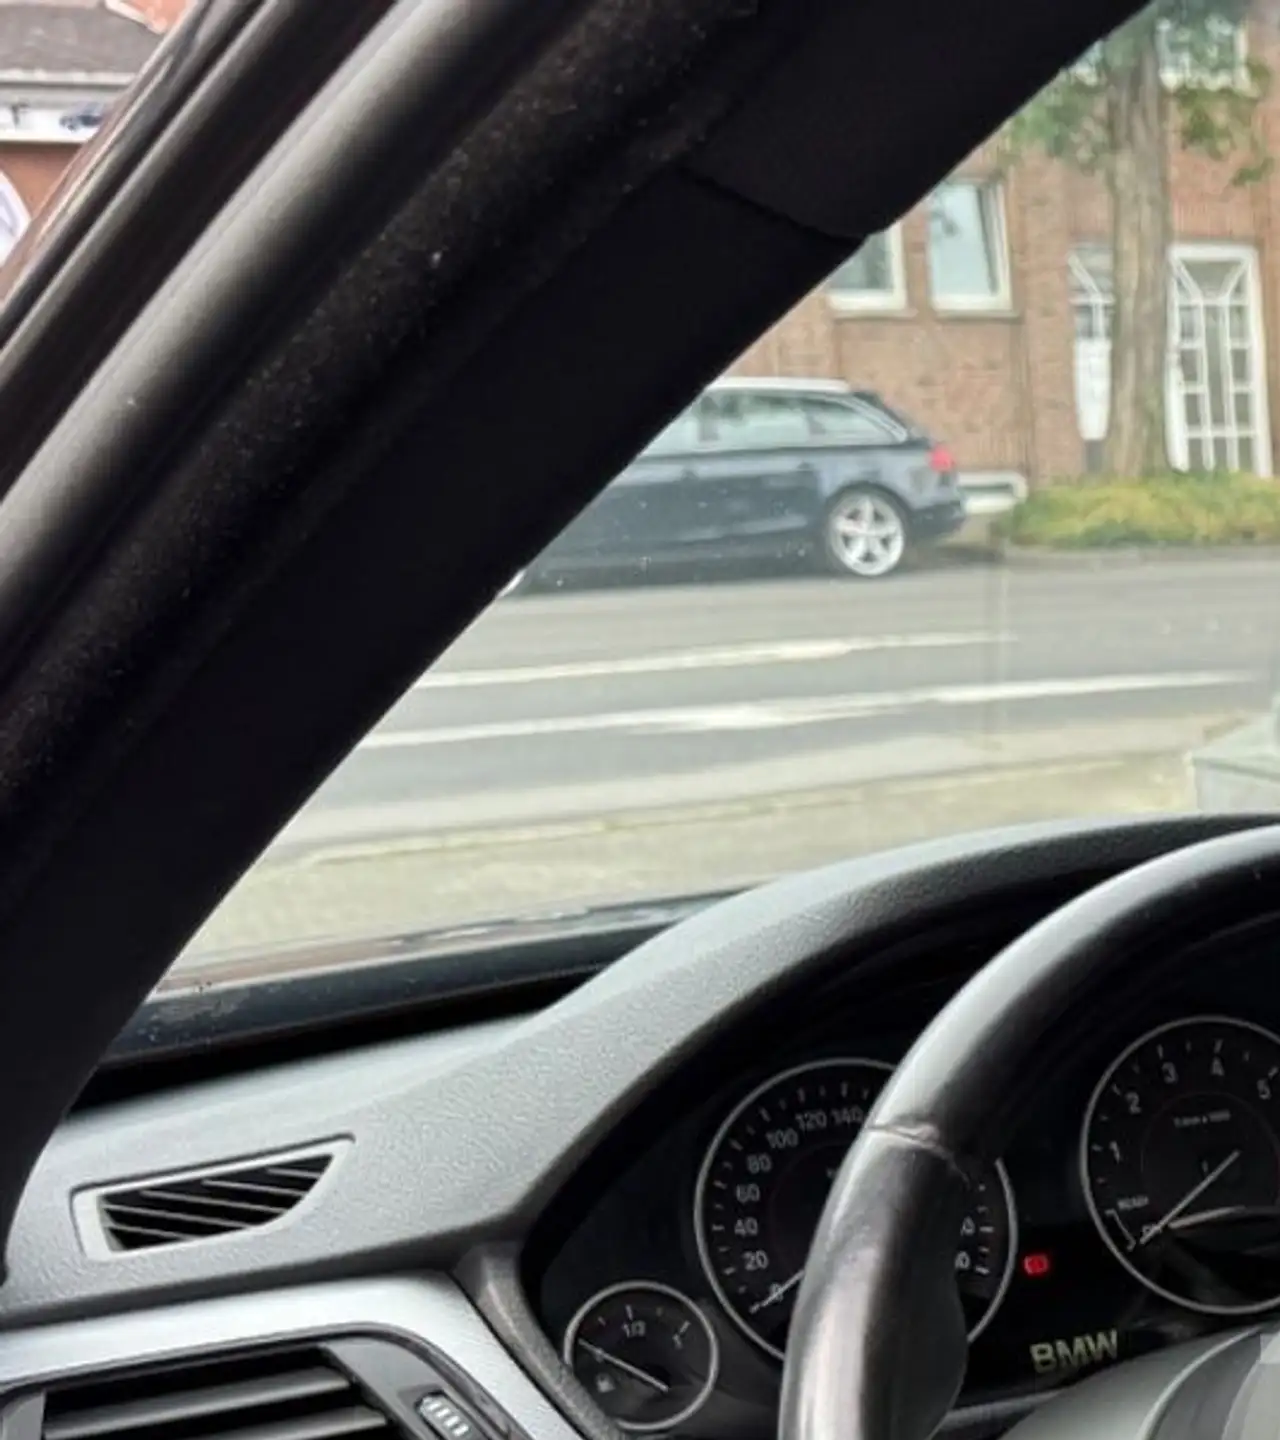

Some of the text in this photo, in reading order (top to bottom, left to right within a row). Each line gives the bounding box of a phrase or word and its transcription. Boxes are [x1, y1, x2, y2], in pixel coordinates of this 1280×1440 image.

[1161, 1061, 1178, 1084] 3
[1256, 1078, 1272, 1101] 5
[1125, 1091, 1141, 1115] 2
[795, 1109, 827, 1132] 120
[765, 1128, 799, 1149] 100
[1109, 1140, 1122, 1163] 1
[746, 1154, 772, 1174] 80
[735, 1183, 760, 1204] 60
[733, 1217, 758, 1237] 40
[742, 1250, 769, 1270] 20
[1029, 1328, 1118, 1374] BMW
